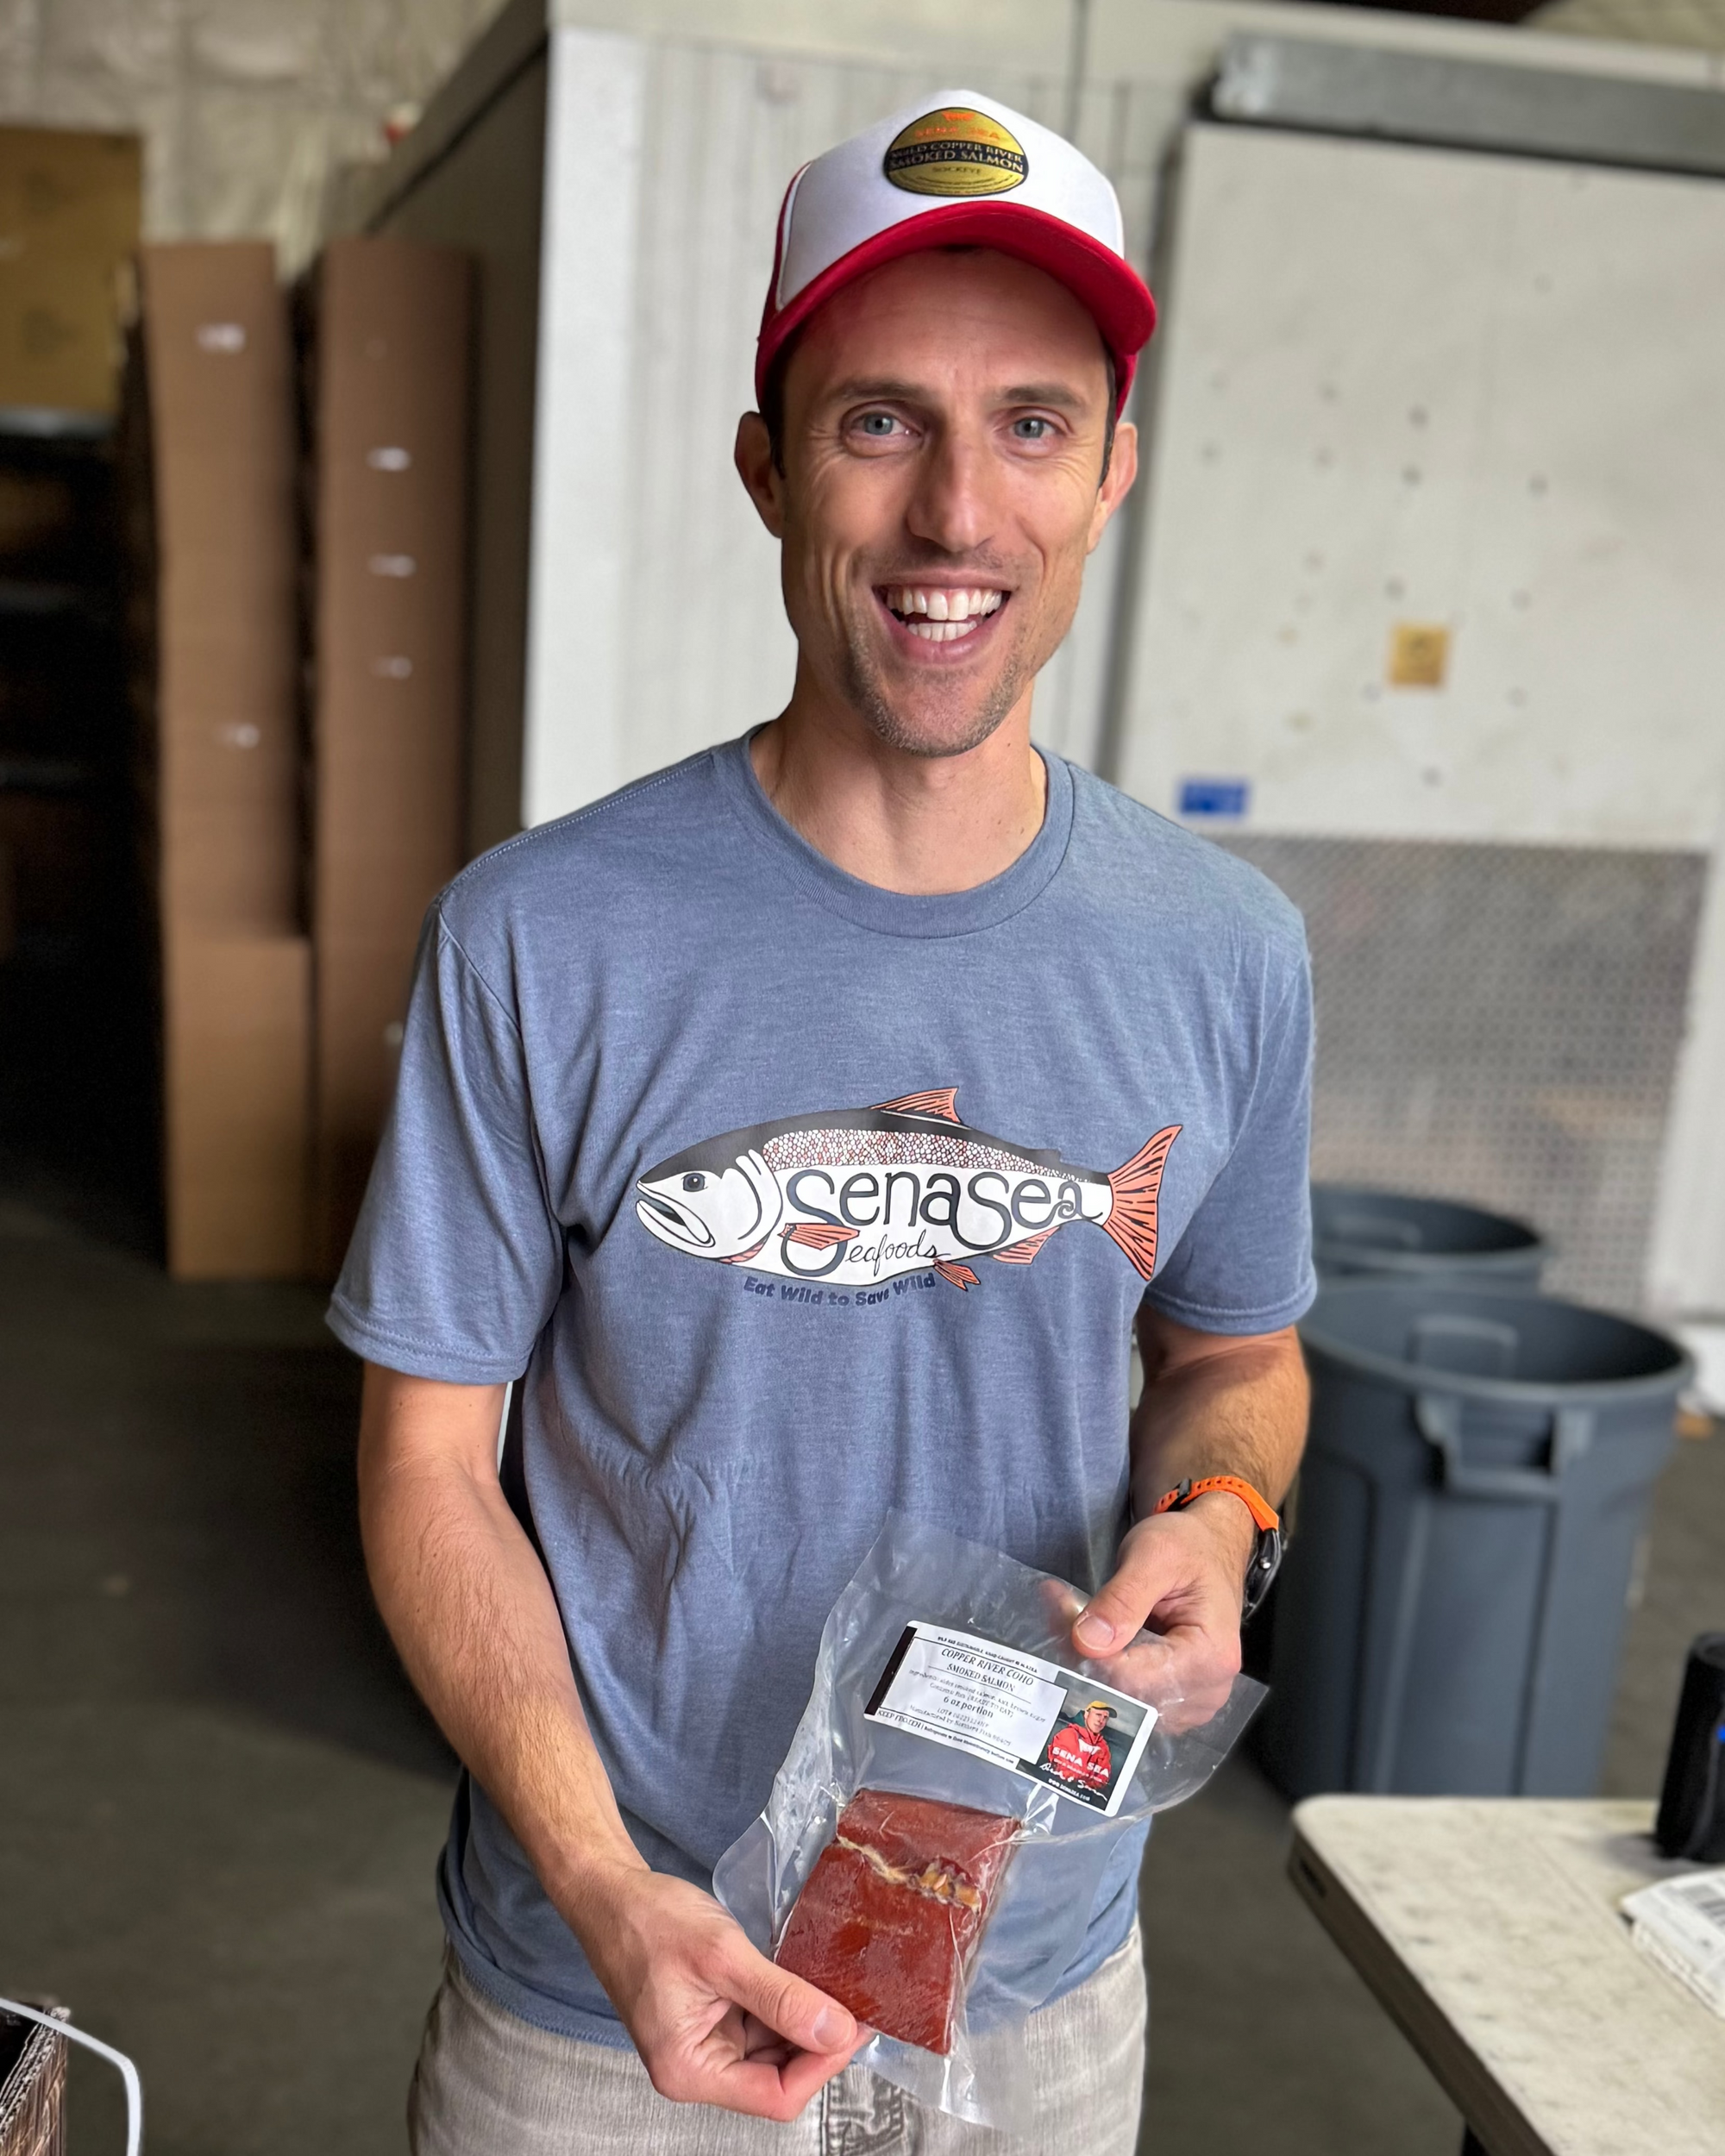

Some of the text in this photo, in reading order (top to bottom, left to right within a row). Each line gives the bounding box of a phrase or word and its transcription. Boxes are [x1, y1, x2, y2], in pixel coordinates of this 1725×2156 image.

[889, 149, 1025, 173] SMOKED SALMON
[891, 141, 1024, 164] WILD COPPER RIVER
[932, 165, 981, 175] SOCKEYE
[743, 1272, 937, 1307] Eat Wild to Save Wild
[941, 1648, 1034, 1686] COPPER RIVER COHO
[946, 1663, 1016, 1692] SMOKED SALMON
[876, 1709, 895, 1720] KEEP
[943, 1695, 950, 1704] 6
[960, 1700, 994, 1719] portion
[1051, 1745, 1083, 1767] SENA
[1087, 1761, 1110, 1778] SEA
